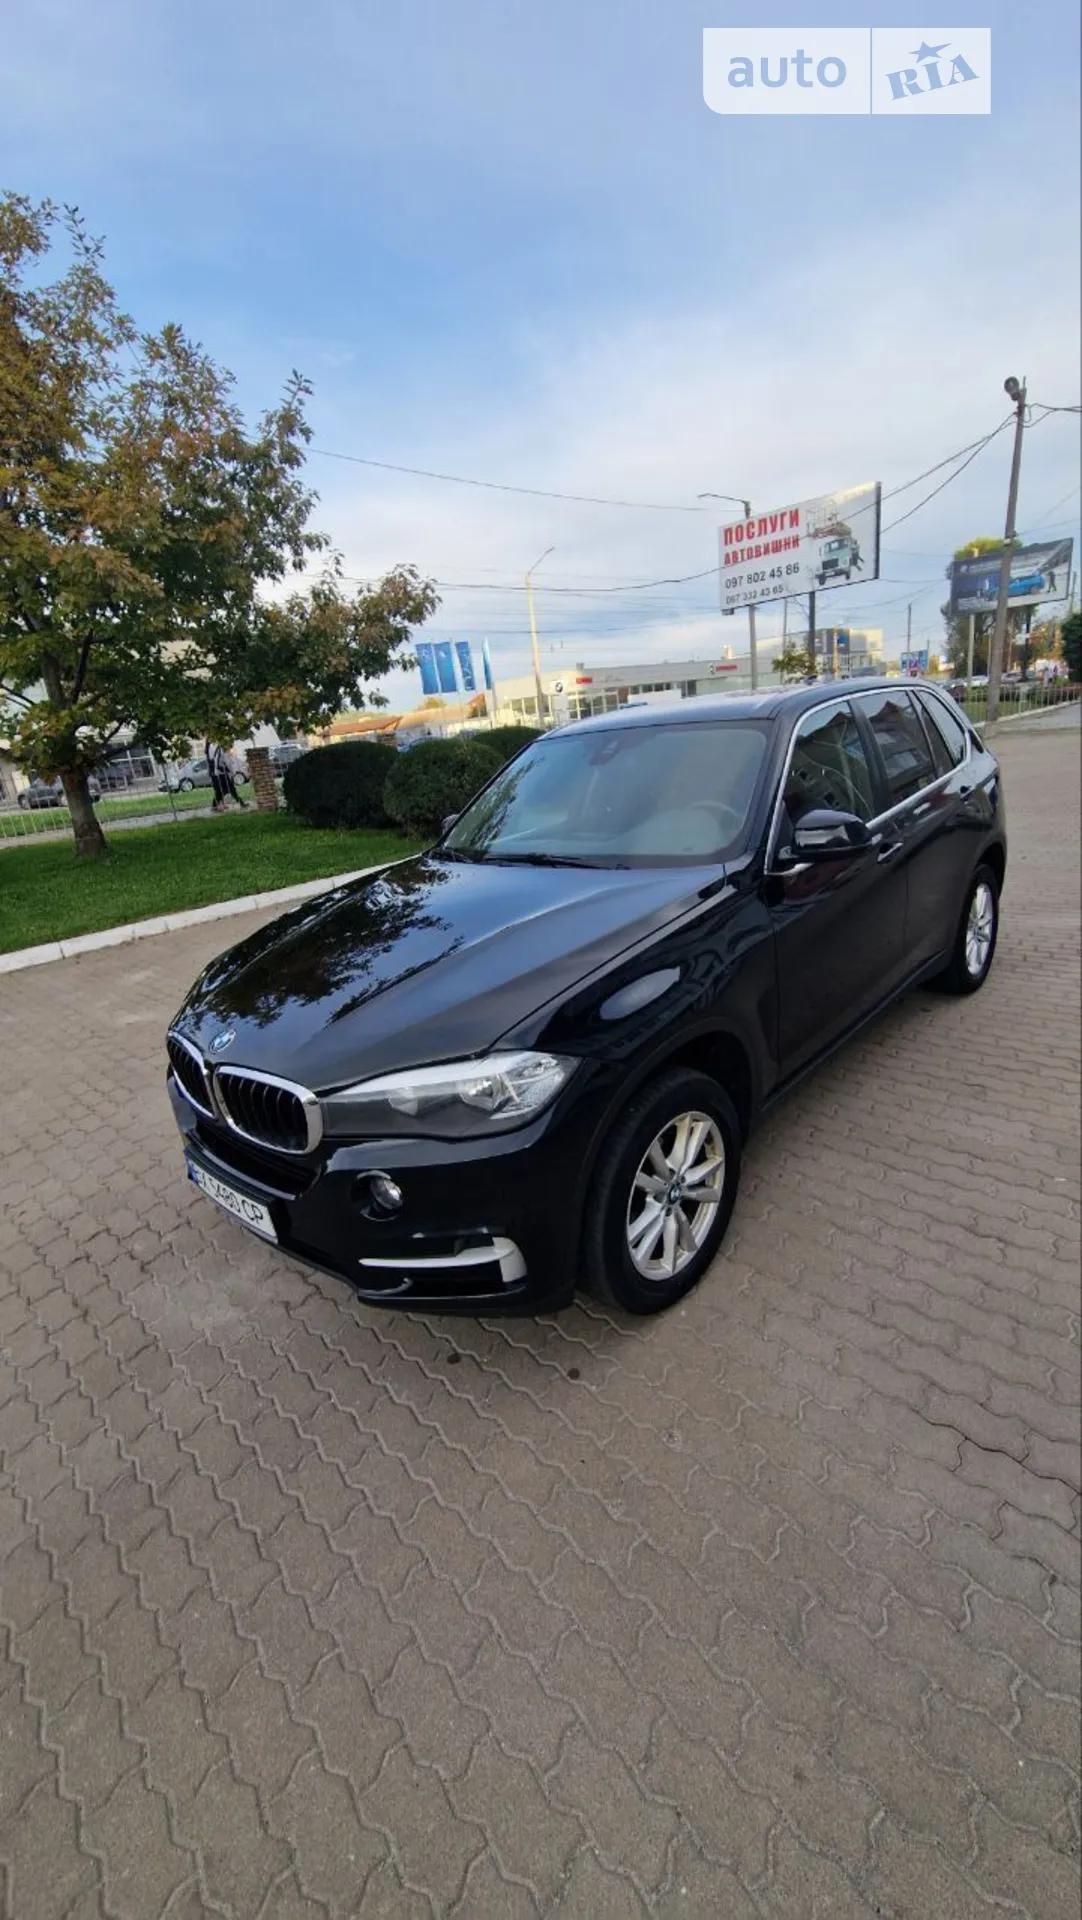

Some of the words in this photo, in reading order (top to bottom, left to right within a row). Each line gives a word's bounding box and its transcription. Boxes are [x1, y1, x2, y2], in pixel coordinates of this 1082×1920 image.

[724, 508, 800, 546] ПОСЛУГИ
[725, 575, 744, 589] 097
[747, 571, 767, 584] 802
[769, 566, 783, 579] 45
